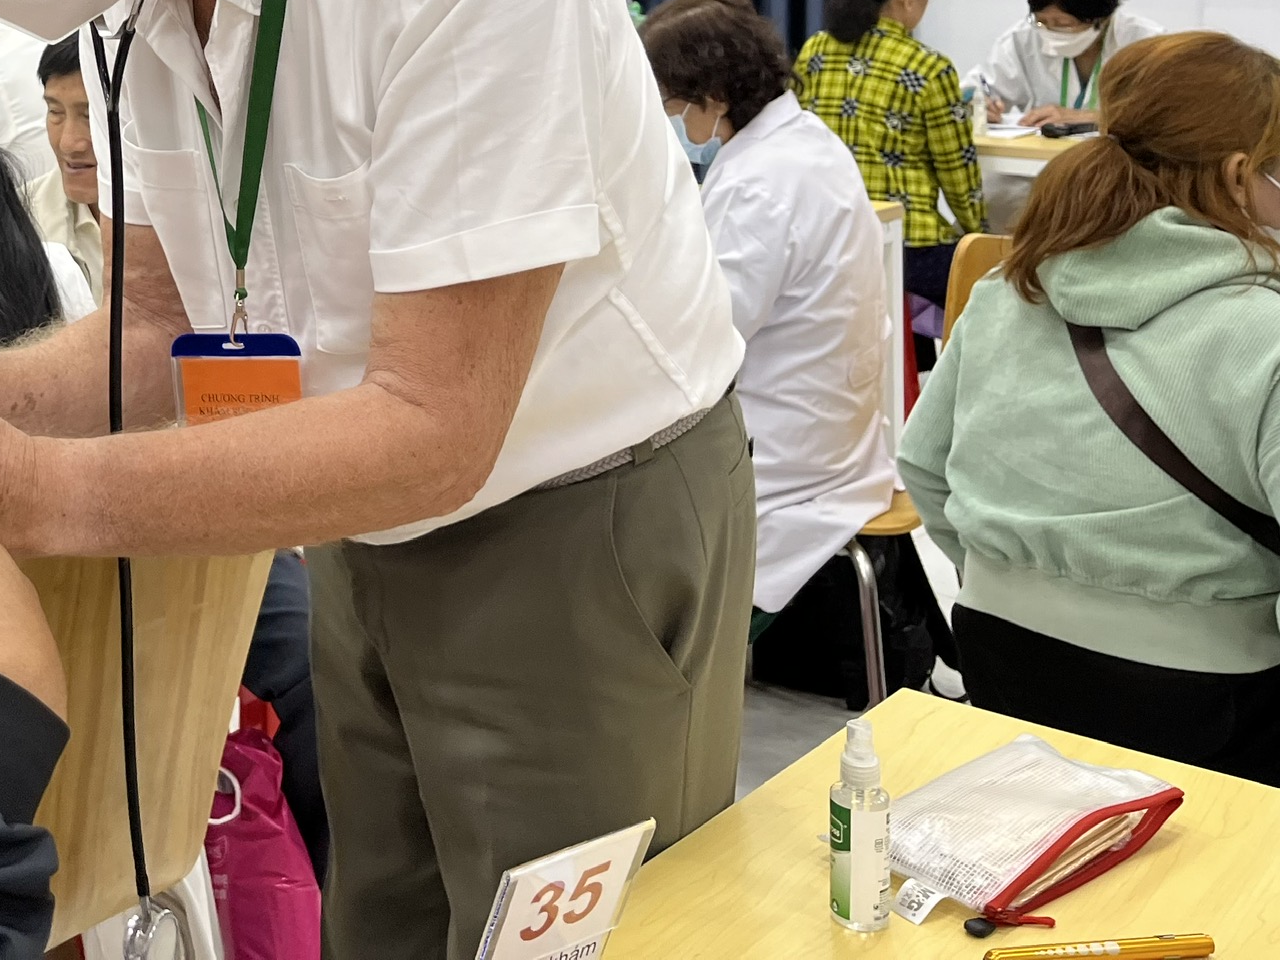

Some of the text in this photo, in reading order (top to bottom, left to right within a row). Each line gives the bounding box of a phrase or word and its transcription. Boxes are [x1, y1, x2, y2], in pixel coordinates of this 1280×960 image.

[249, 391, 280, 403] TRÌNH
[519, 860, 612, 942] 35
[906, 885, 936, 912] M&G
[548, 941, 597, 960] hám
